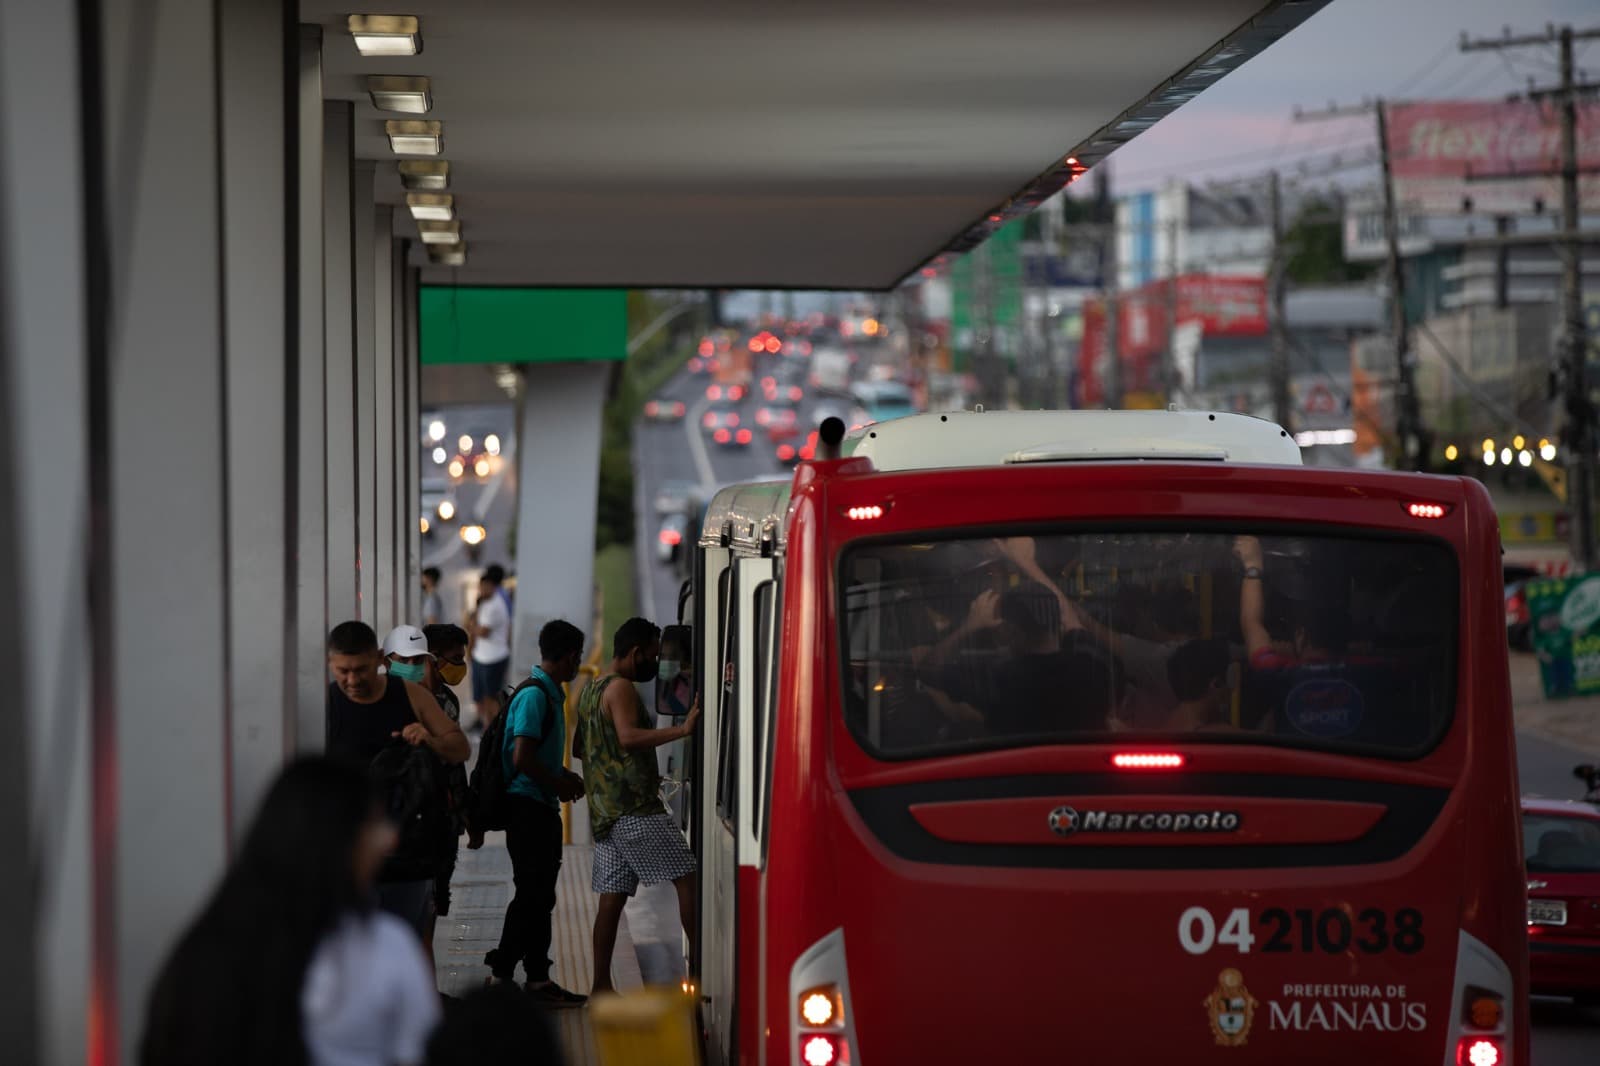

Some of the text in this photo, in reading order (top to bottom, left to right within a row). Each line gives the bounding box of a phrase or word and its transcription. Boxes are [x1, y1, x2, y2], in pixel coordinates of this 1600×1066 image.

[1084, 811, 1238, 831] Marcopolo
[1283, 984, 1406, 998] PREFEITURA DE
[1268, 1001, 1427, 1031] MANAUS
